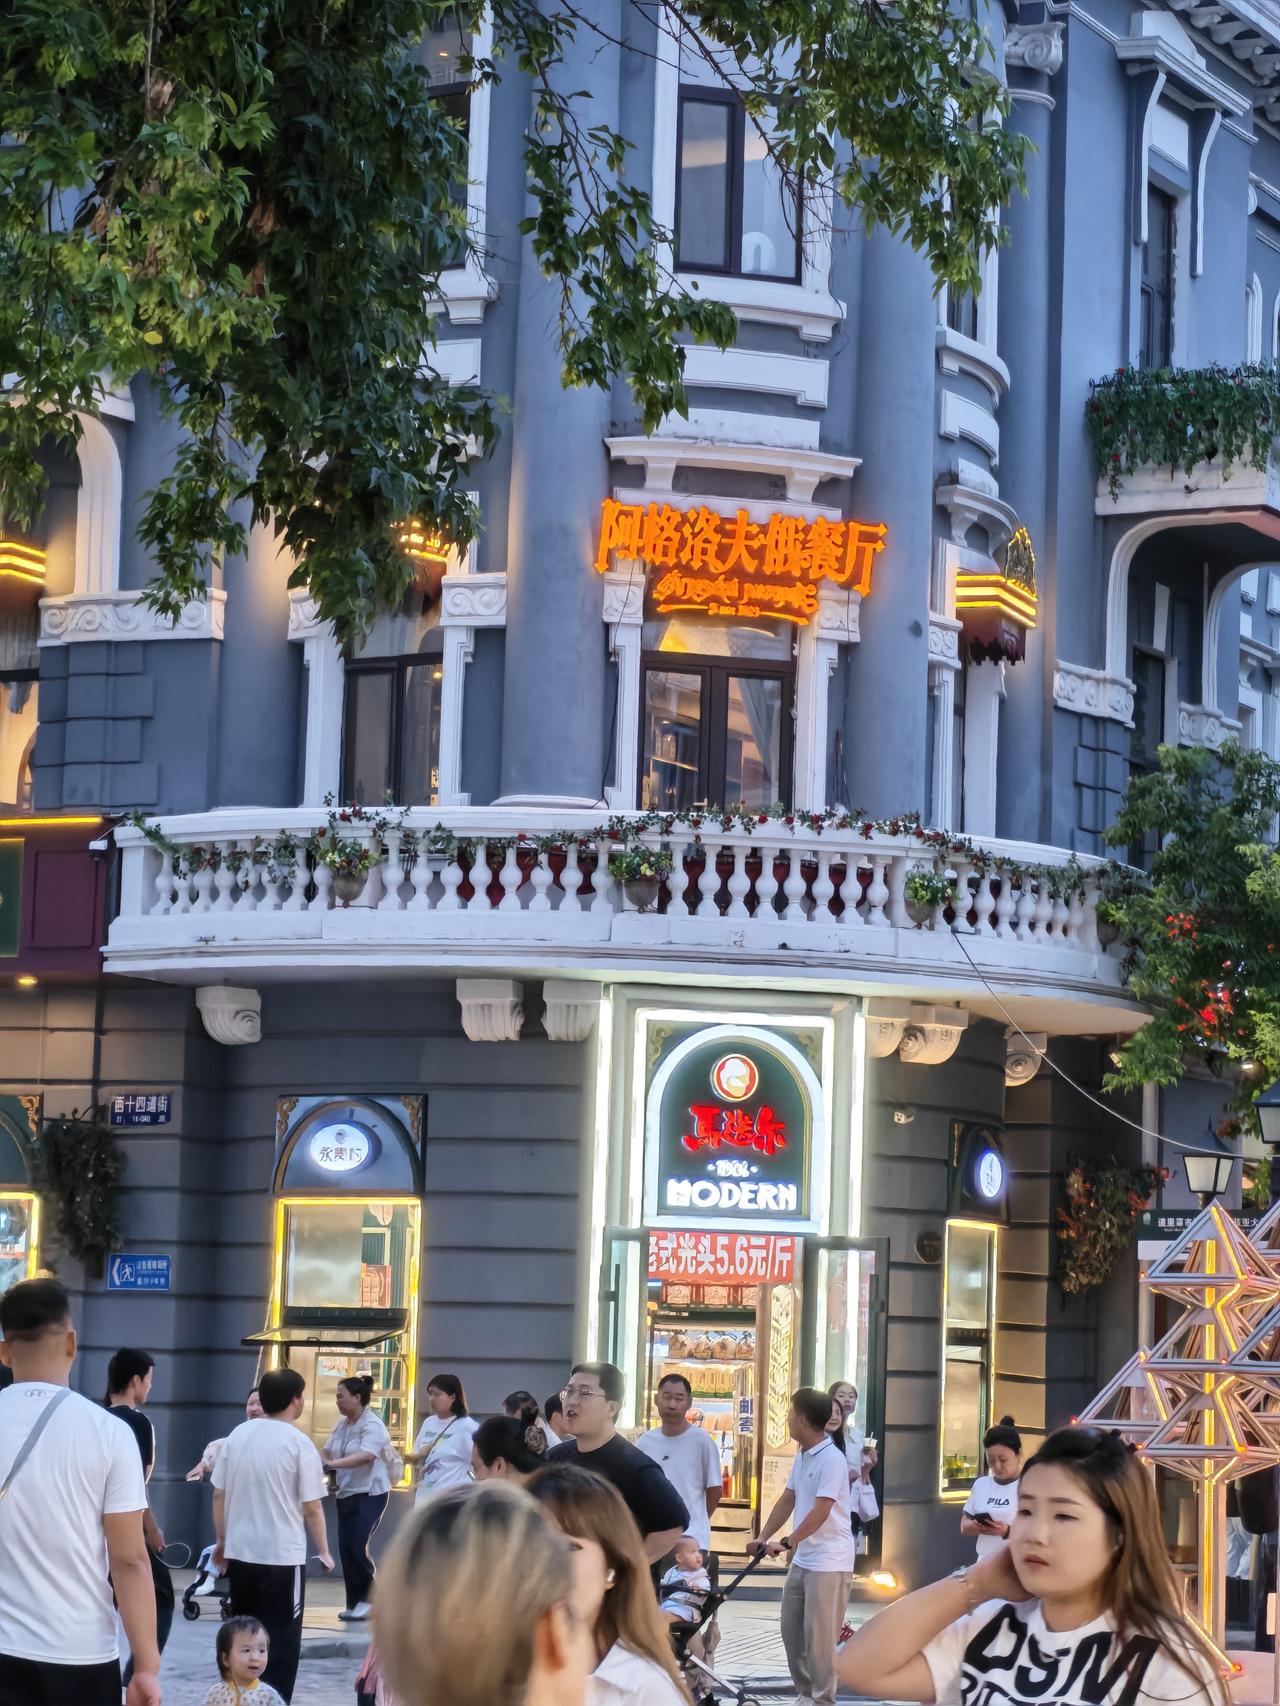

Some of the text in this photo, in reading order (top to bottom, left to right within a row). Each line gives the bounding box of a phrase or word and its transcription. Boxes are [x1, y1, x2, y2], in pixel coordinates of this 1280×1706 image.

[114, 1095, 168, 1113] 西十四道街
[666, 1178, 797, 1210] MODERN
[987, 1497, 1010, 1506] FILA
